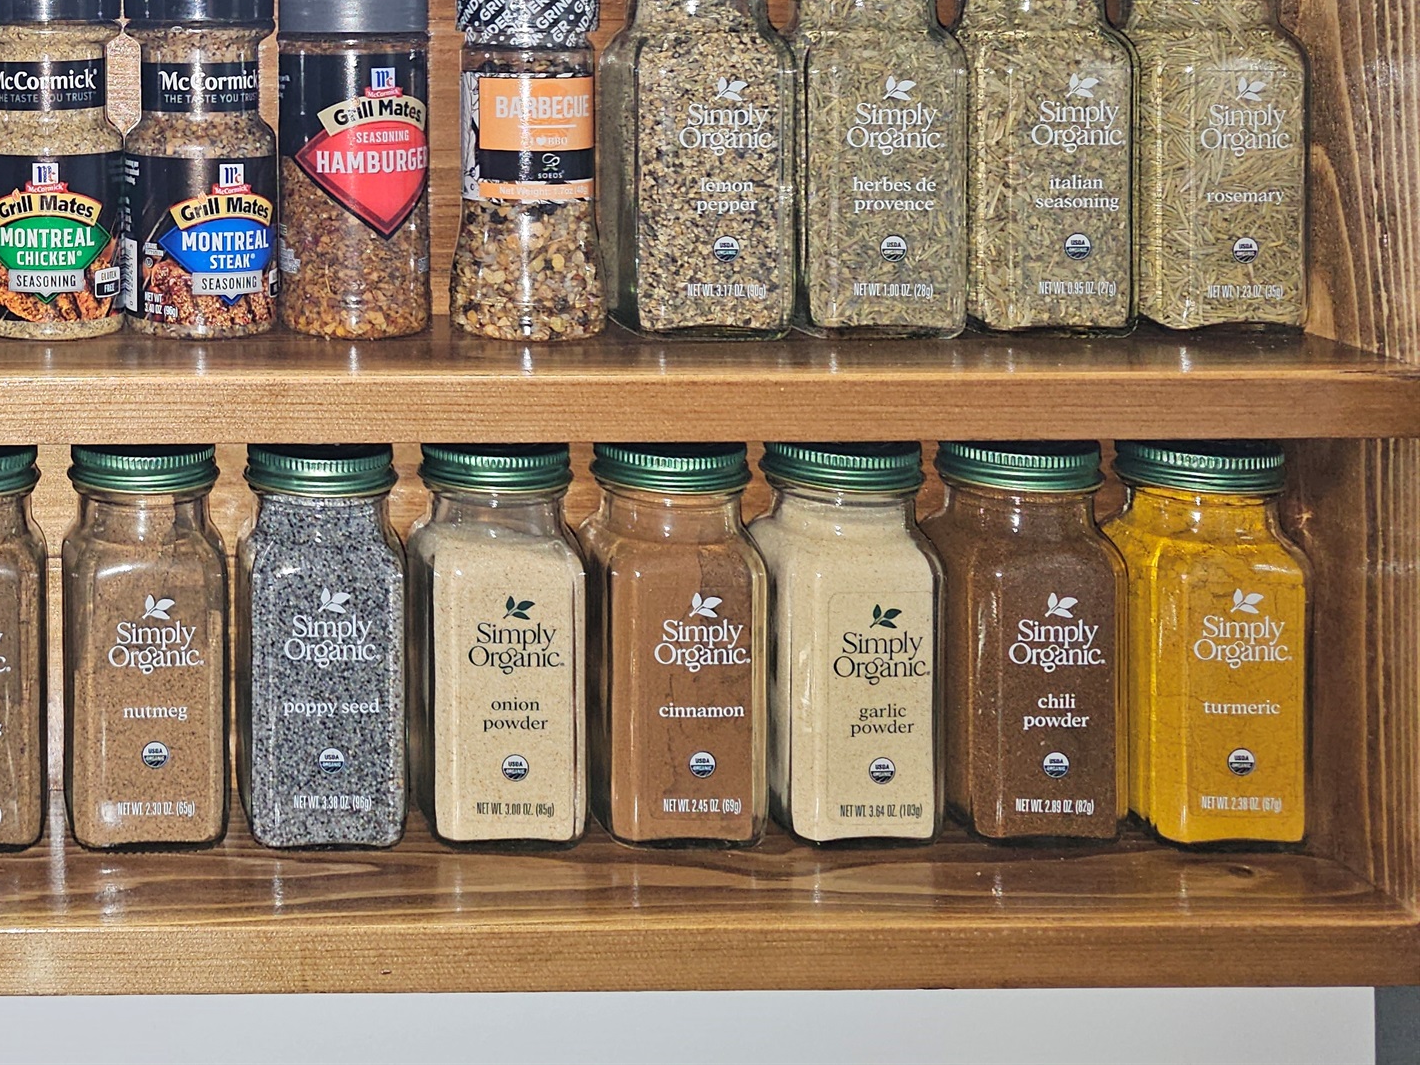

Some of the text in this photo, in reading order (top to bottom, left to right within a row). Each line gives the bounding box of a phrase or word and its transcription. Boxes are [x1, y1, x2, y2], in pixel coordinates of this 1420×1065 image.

[496, 96, 589, 118] BARBECUE
[1040, 101, 1119, 128] Simply
[356, 130, 410, 143] SEASONING
[700, 178, 753, 193] lemon
[852, 178, 936, 192] herbes de
[1049, 176, 1103, 190] italian
[1036, 195, 1119, 210] seasoning
[1207, 190, 1284, 205] rosemary
[697, 199, 757, 214] pepper
[854, 198, 934, 213] provence
[0, 227, 94, 248] MONTREAL
[182, 230, 268, 251] MONTREAL
[16, 251, 76, 265] CHICKEN
[210, 255, 250, 269] STEAK
[476, 622, 556, 653] Simply
[1018, 619, 1099, 647] Simply
[284, 699, 380, 716] poppy seed
[491, 699, 540, 711] onion
[1038, 694, 1076, 709] chili
[1204, 701, 1280, 715] turmeric
[124, 706, 188, 720] nutmeg
[659, 704, 745, 717] cinnamon
[859, 704, 906, 720] garlic
[483, 716, 548, 732] powder
[851, 721, 914, 737] powder
[1023, 714, 1089, 730] powder
[663, 799, 677, 812] NET
[692, 800, 707, 812] 2.45
[722, 798, 741, 814] (69g)
